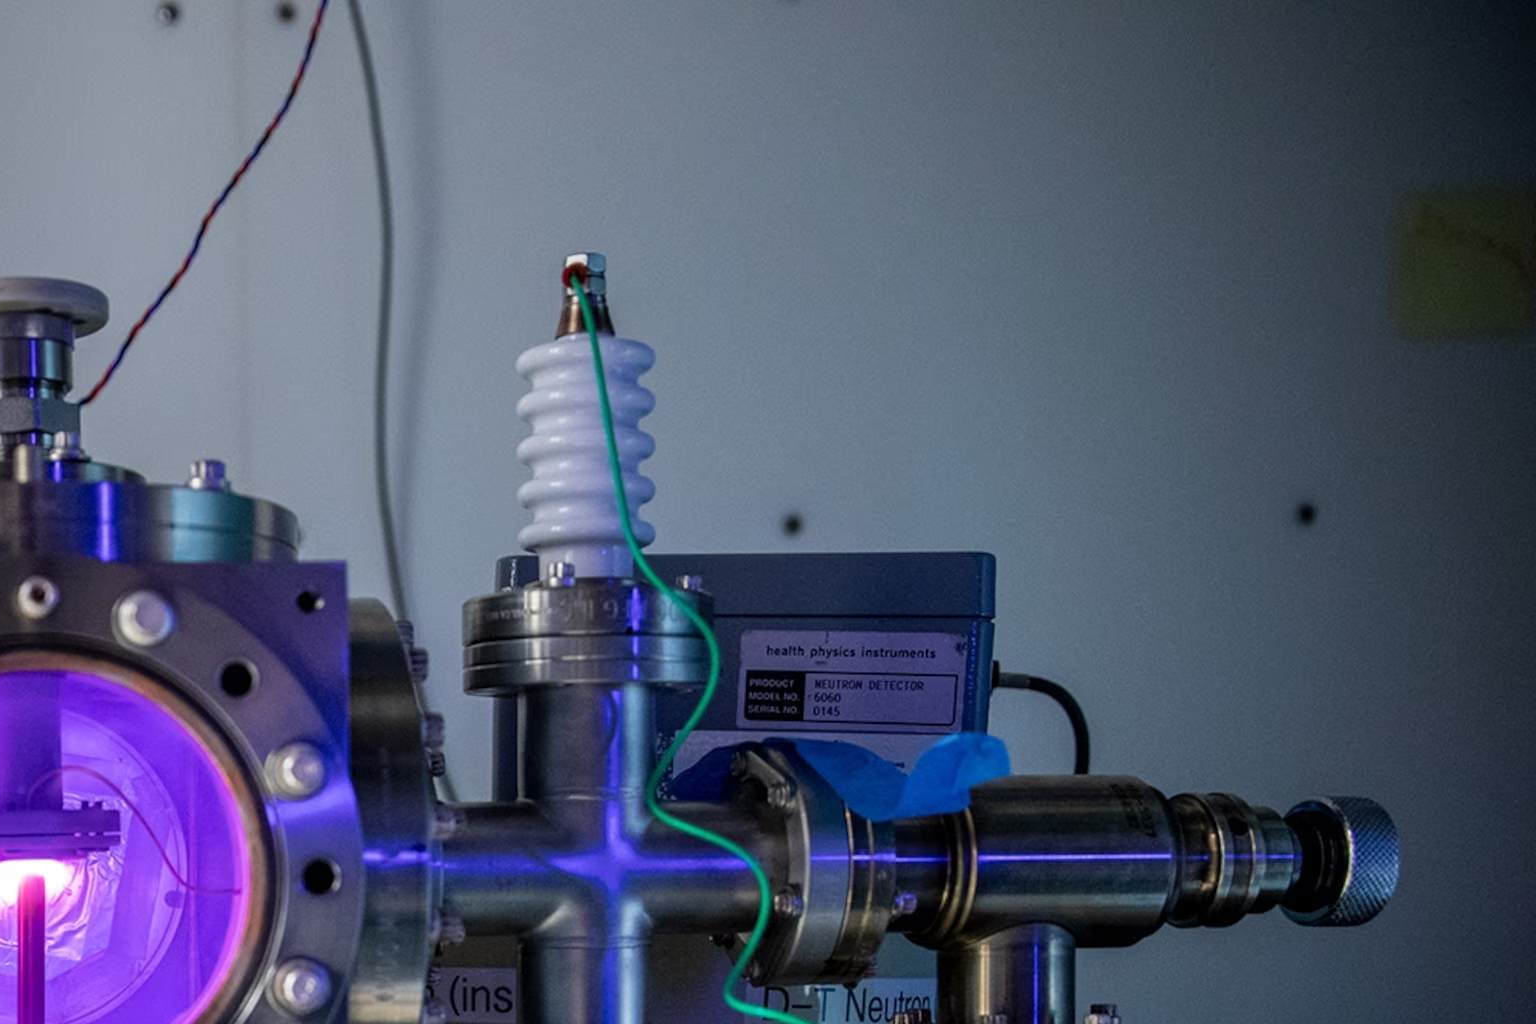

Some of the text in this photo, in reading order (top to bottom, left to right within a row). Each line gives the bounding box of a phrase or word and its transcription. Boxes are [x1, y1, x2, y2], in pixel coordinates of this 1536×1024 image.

[766, 645, 936, 659] health physics instruments
[748, 678, 924, 691] PRODUCT NEUTRON DETECTOR
[747, 691, 842, 703] MODEL NO. 6060
[747, 704, 780, 714] SERIAL
[812, 705, 841, 717] 0145
